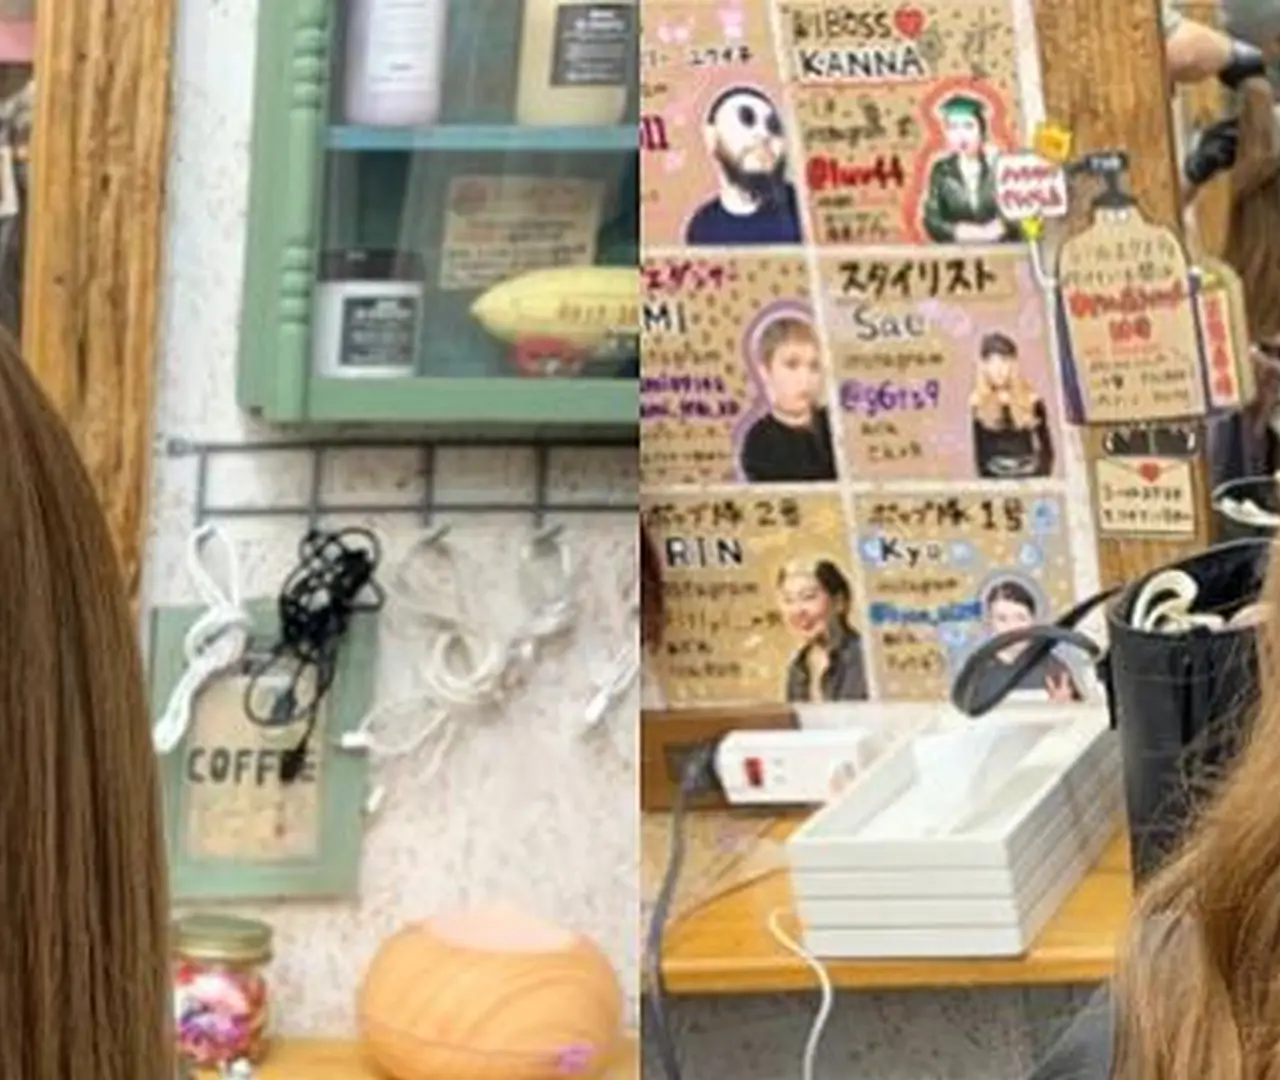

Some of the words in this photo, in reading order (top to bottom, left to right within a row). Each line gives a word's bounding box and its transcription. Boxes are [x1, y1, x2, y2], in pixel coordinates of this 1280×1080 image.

[800, 46, 923, 77] KANNA
[840, 259, 995, 300] スタイリスト
[666, 537, 742, 567] RIN
[187, 745, 317, 785] COFFE
